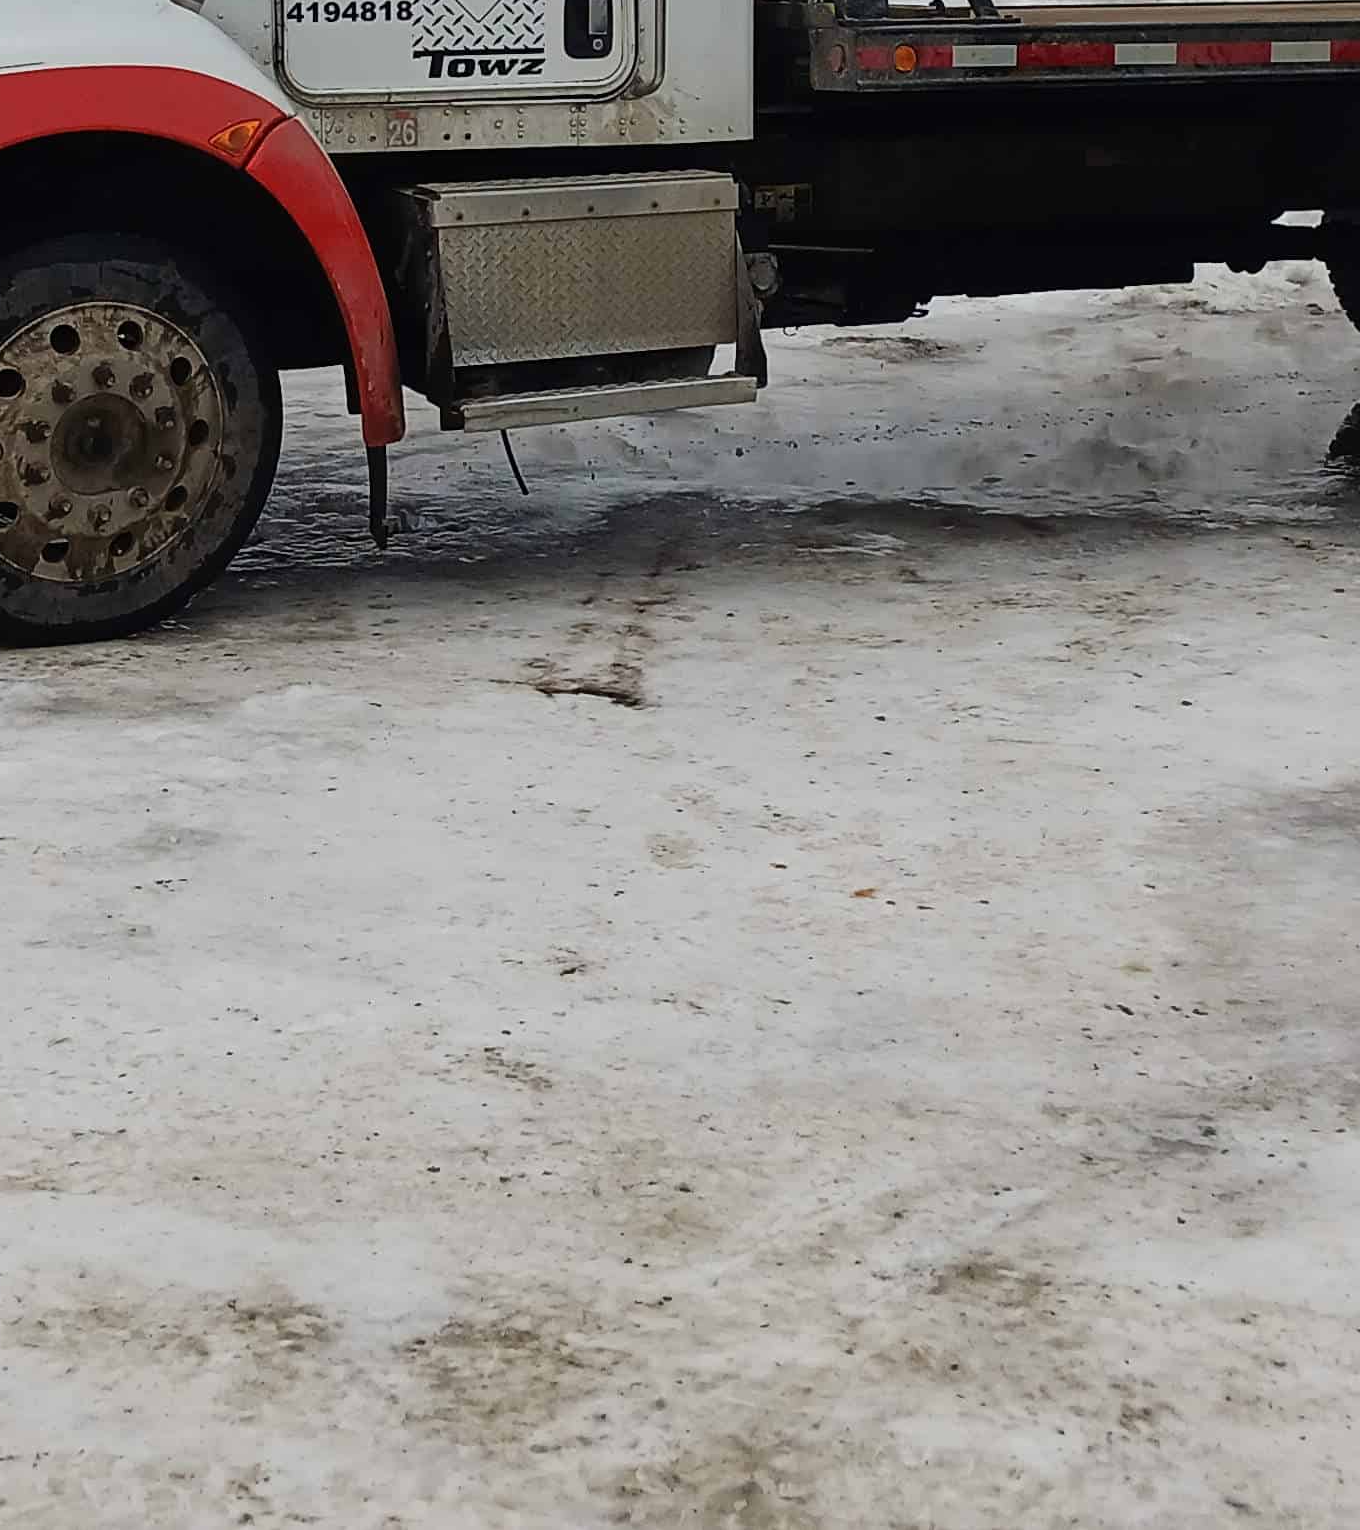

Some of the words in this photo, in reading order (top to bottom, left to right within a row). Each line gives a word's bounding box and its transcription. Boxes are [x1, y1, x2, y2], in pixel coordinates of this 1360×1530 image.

[286, 1, 414, 22] 4194818
[412, 48, 546, 78] Towz
[388, 120, 415, 145] 26
